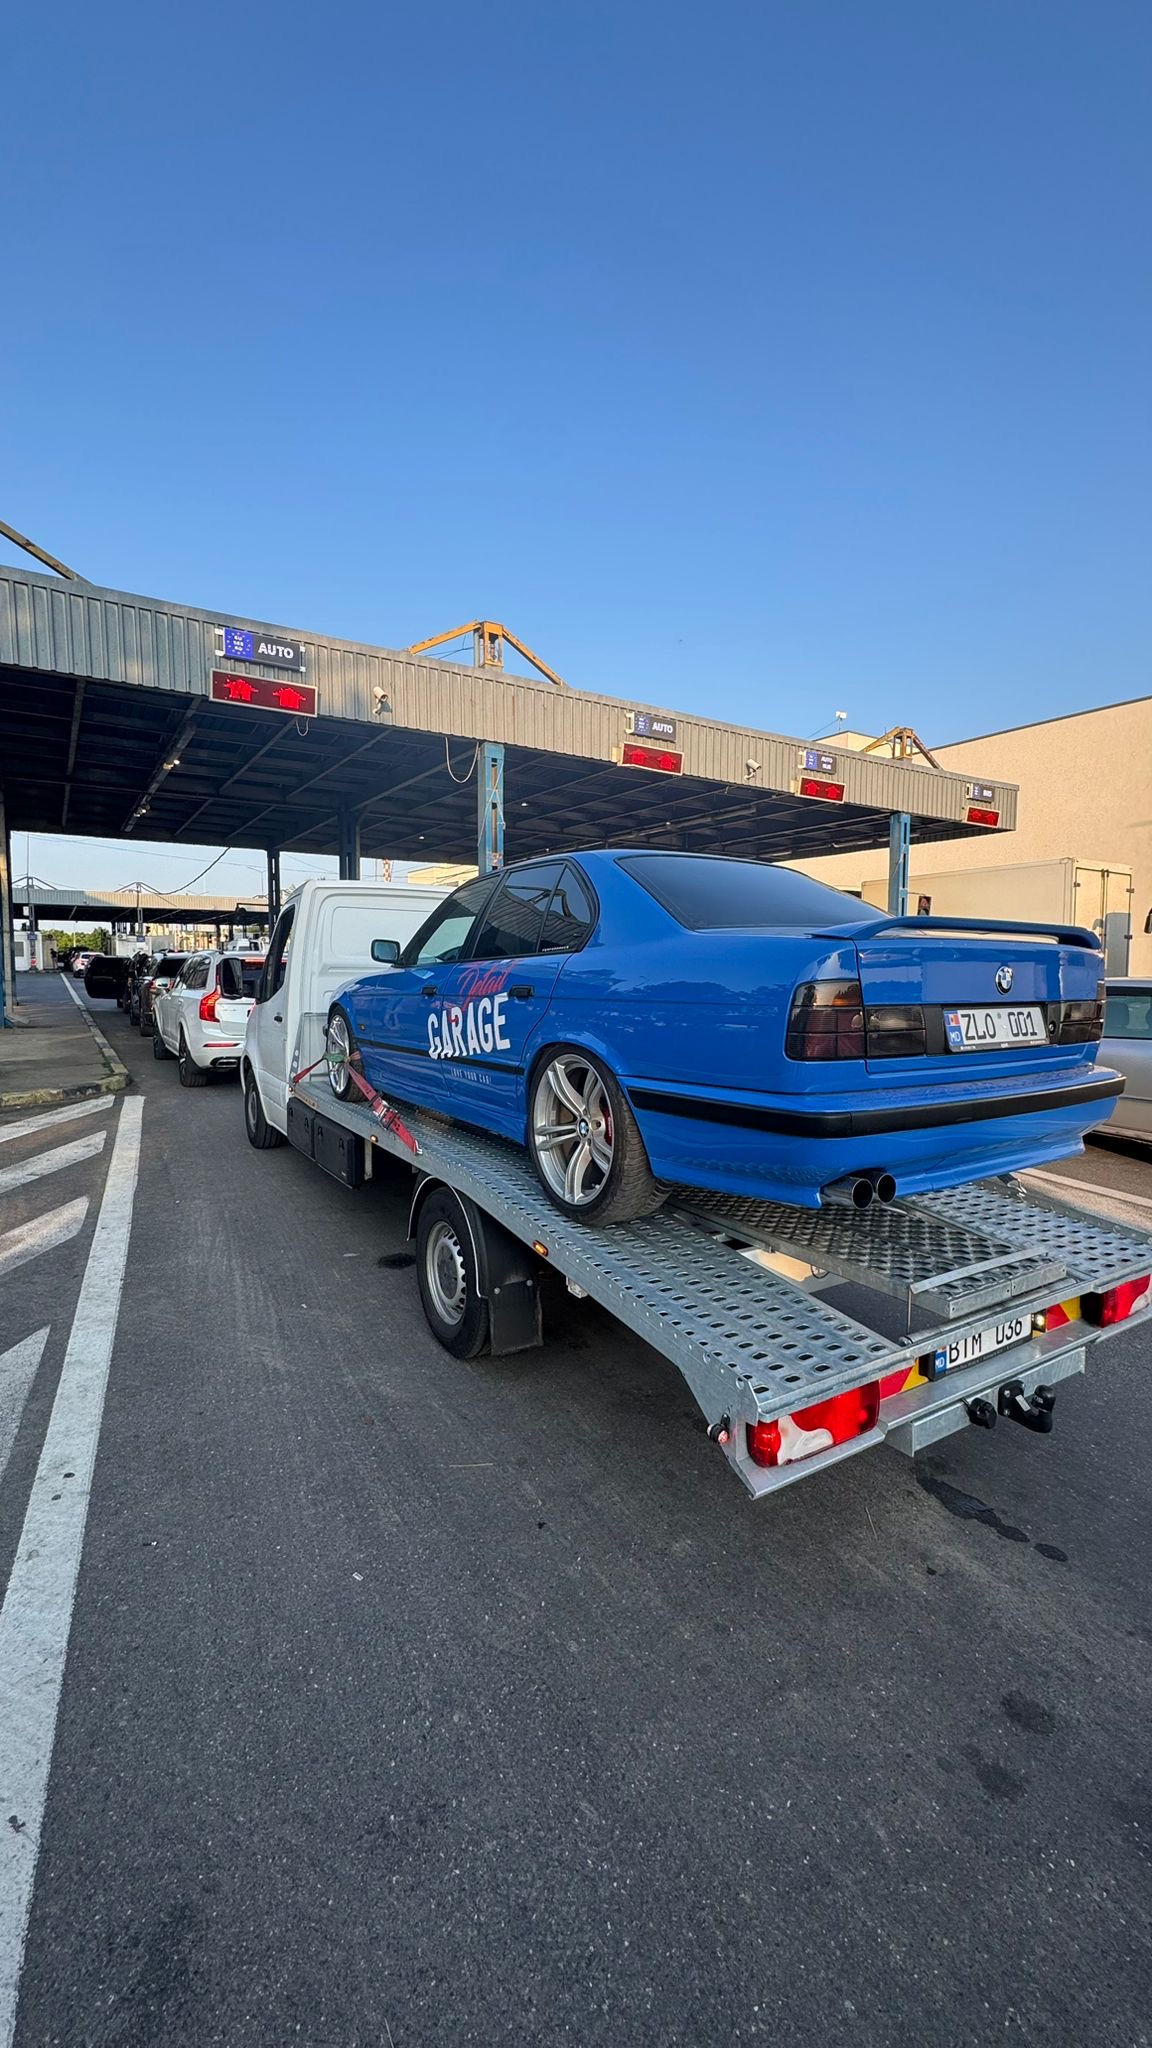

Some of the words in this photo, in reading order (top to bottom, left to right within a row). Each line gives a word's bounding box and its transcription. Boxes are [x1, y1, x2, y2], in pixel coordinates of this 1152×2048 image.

[258, 642, 294, 659] AUTO
[652, 721, 673, 734] AUTO
[456, 962, 515, 1012] Detail
[427, 992, 511, 1060] GARAGE
[949, 1031, 960, 1042] MD
[961, 1013, 997, 1041] ZLO
[1007, 1011, 1038, 1037] 001
